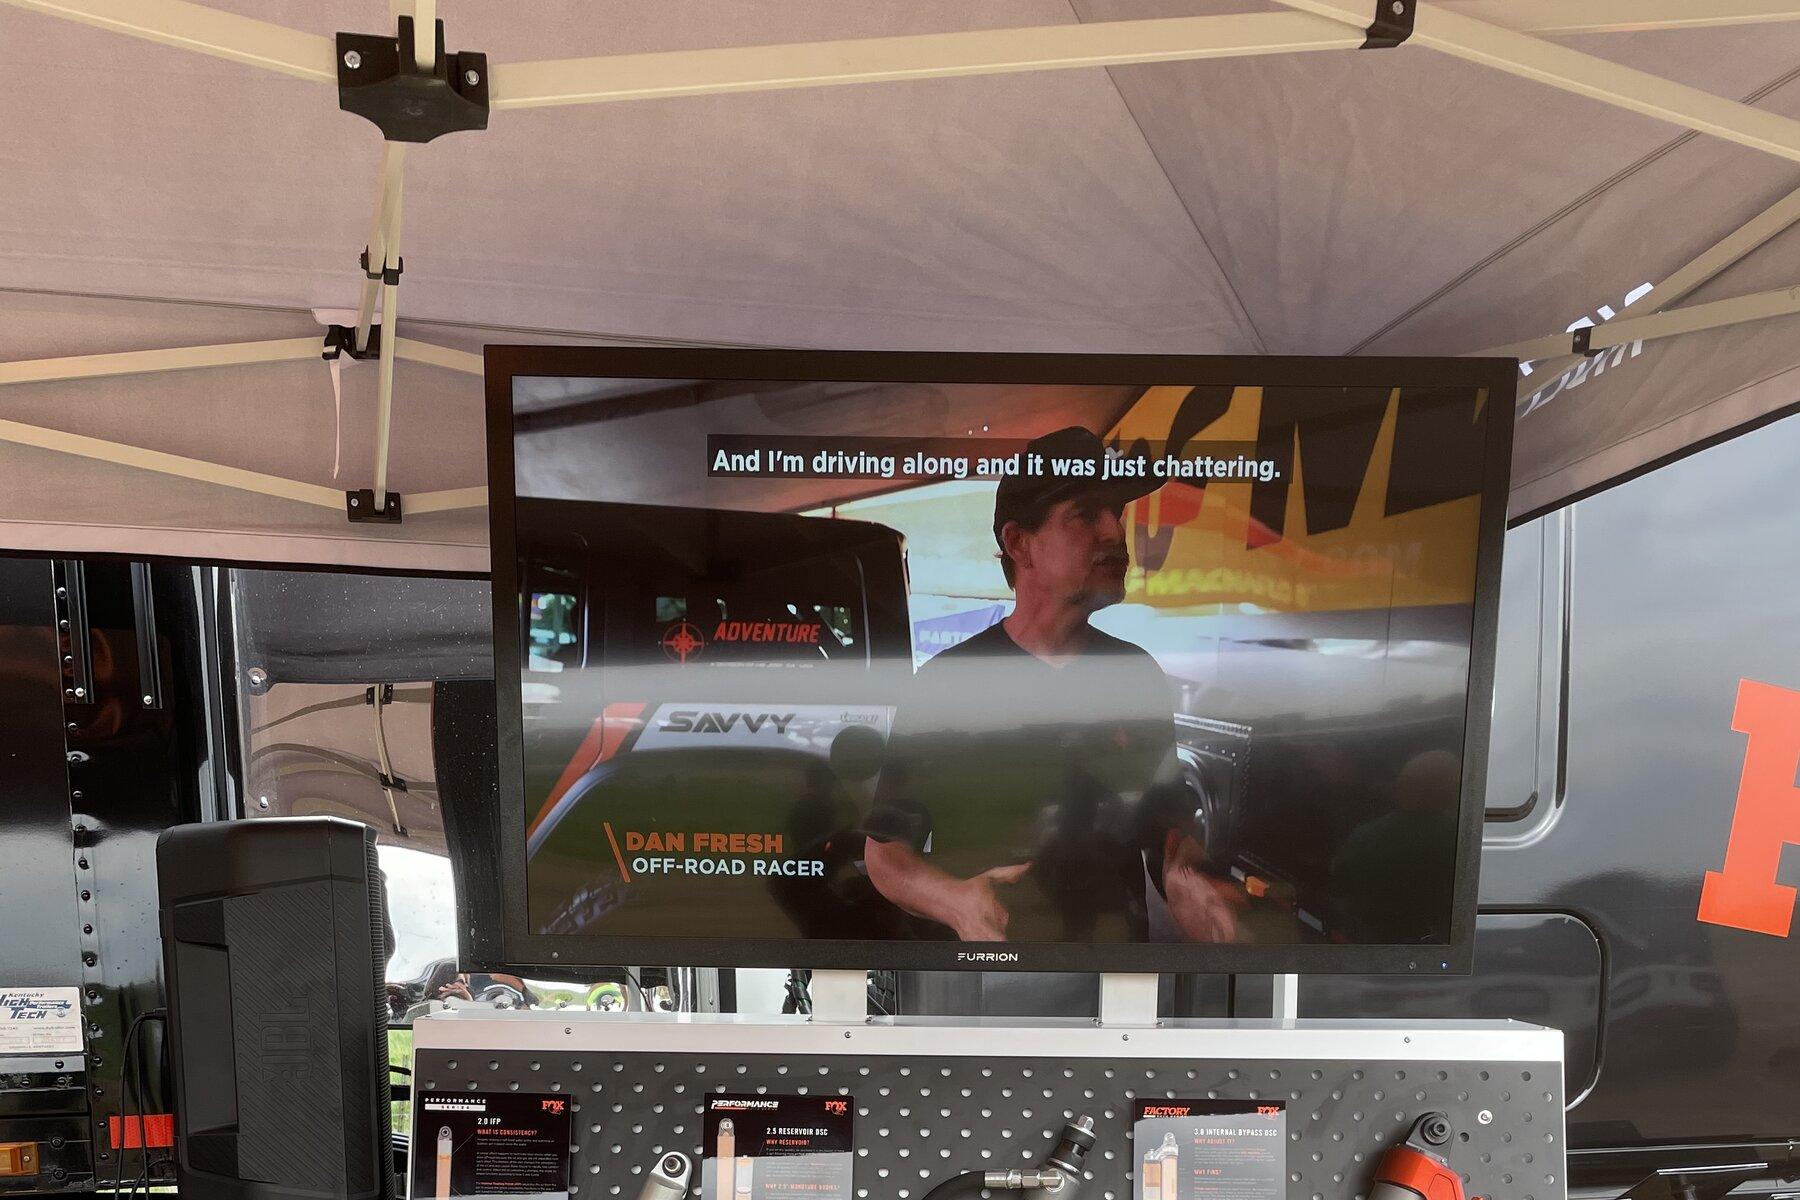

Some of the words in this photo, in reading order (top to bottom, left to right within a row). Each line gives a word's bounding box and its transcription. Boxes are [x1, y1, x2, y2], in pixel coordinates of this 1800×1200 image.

[713, 449, 760, 472] And
[768, 450, 804, 473] I'm
[812, 450, 895, 478] driving
[902, 452, 968, 479] along
[976, 453, 1019, 476] and
[1027, 453, 1043, 476] it
[1051, 458, 1096, 477] was
[1101, 453, 1146, 481] just
[1153, 454, 1281, 481] chattering.
[713, 622, 821, 644] ADVENTURE
[659, 710, 796, 734] SAVVY
[626, 831, 684, 851] DAN
[693, 832, 783, 854] FRESH
[632, 857, 746, 876] OFF-ROAD
[753, 859, 825, 877] RACER
[957, 952, 1018, 962] FURRION
[541, 1100, 565, 1115] FOX
[711, 1099, 779, 1109] PERFORMANCE
[825, 1100, 847, 1115] FOX
[1143, 1106, 1191, 1116] FACTORY
[477, 1117, 488, 1125] 2.0
[490, 1117, 502, 1125] IFP
[766, 1127, 777, 1135] 2.5
[778, 1127, 813, 1136] RESERVOIR
[815, 1128, 828, 1136] DSC
[1206, 1128, 1236, 1136] INTERNAL
[1238, 1128, 1263, 1136] BYPASS
